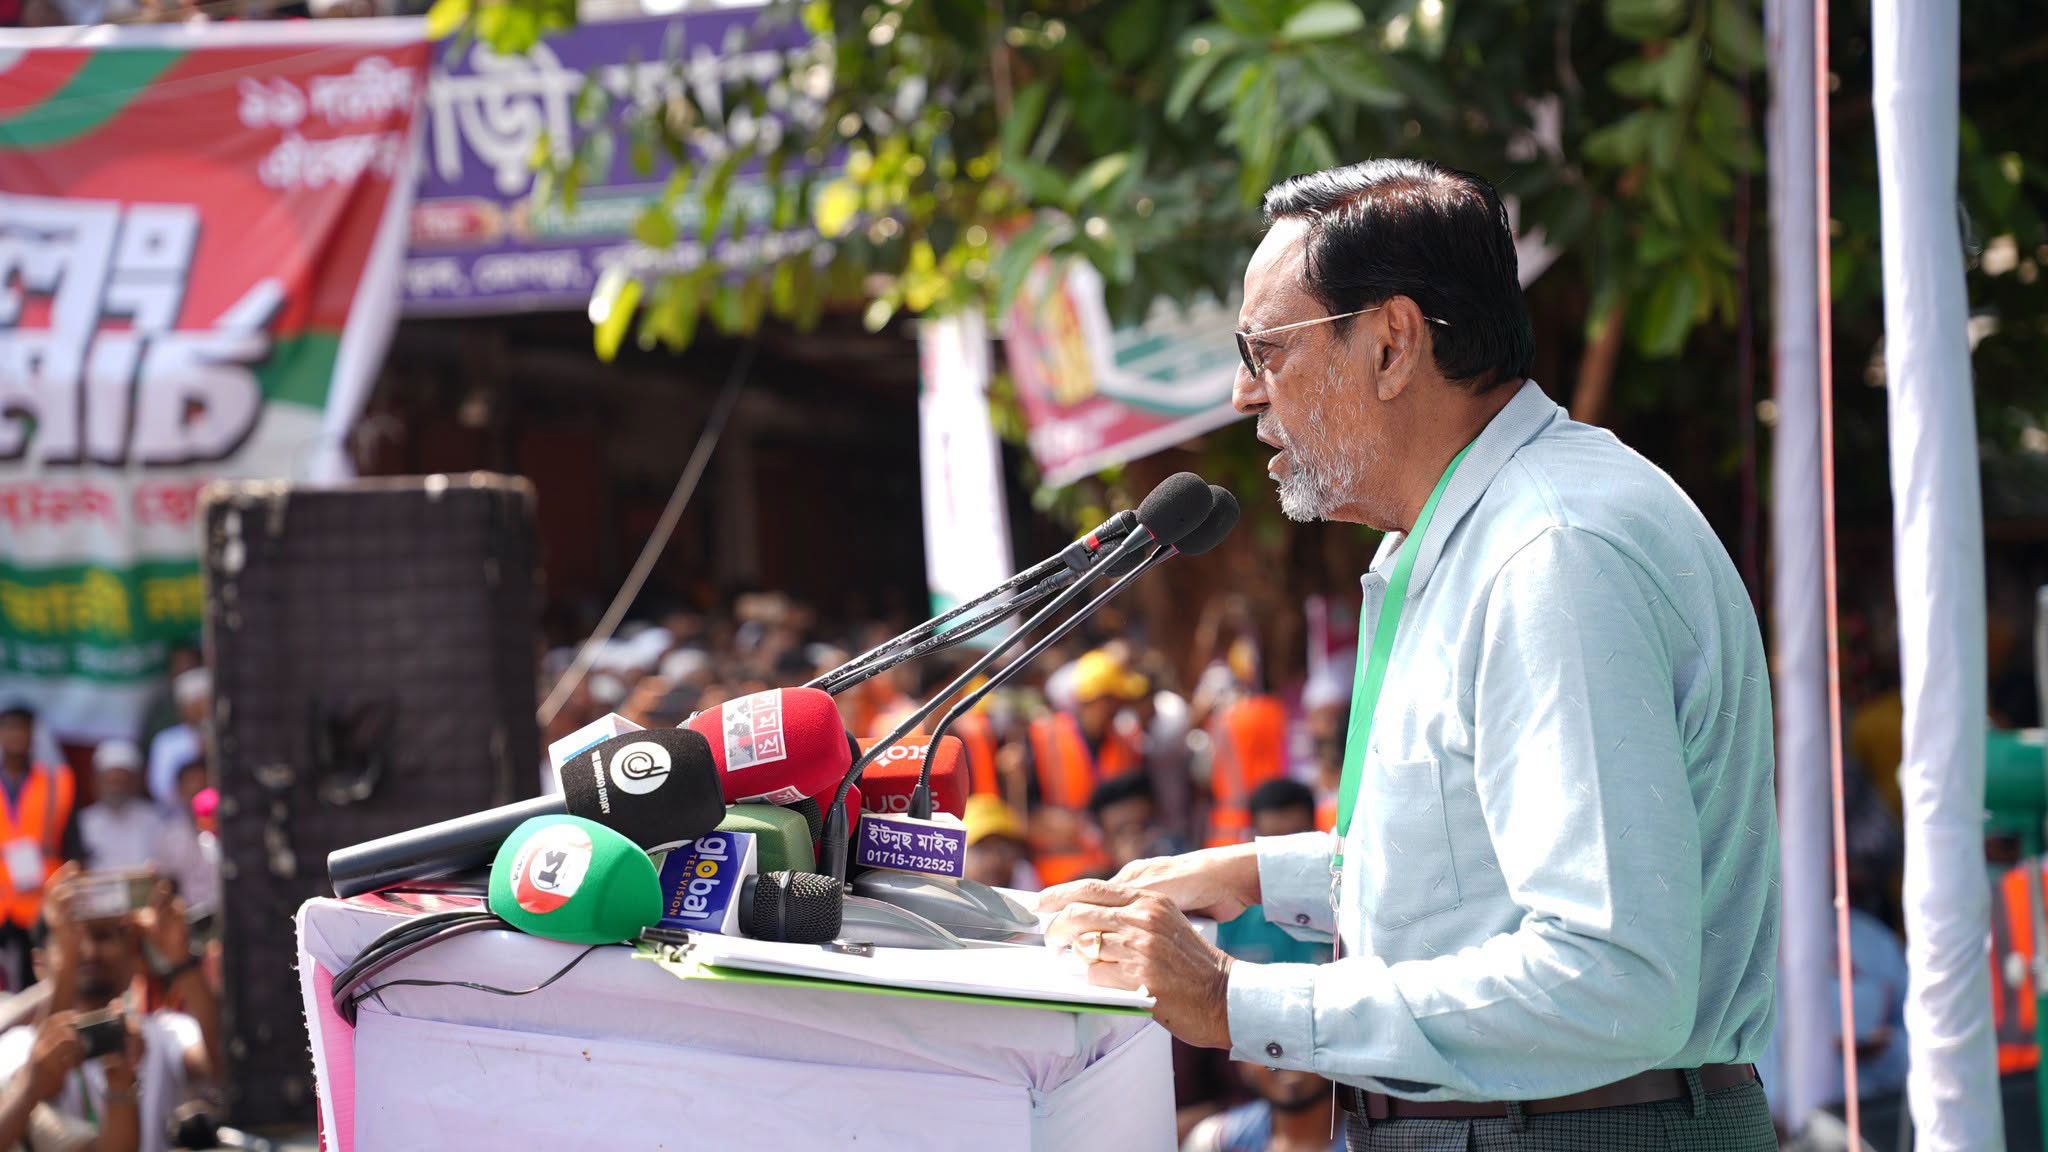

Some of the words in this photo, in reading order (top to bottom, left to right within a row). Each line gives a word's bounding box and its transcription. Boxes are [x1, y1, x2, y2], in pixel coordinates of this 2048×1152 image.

[598, 787, 610, 814] DIARY
[867, 821, 913, 852] ইউনুছ
[917, 831, 959, 855] মাইক
[680, 837, 729, 919] global
[866, 850, 955, 873] 01715-732525
[669, 854, 698, 916] TELEVISION
